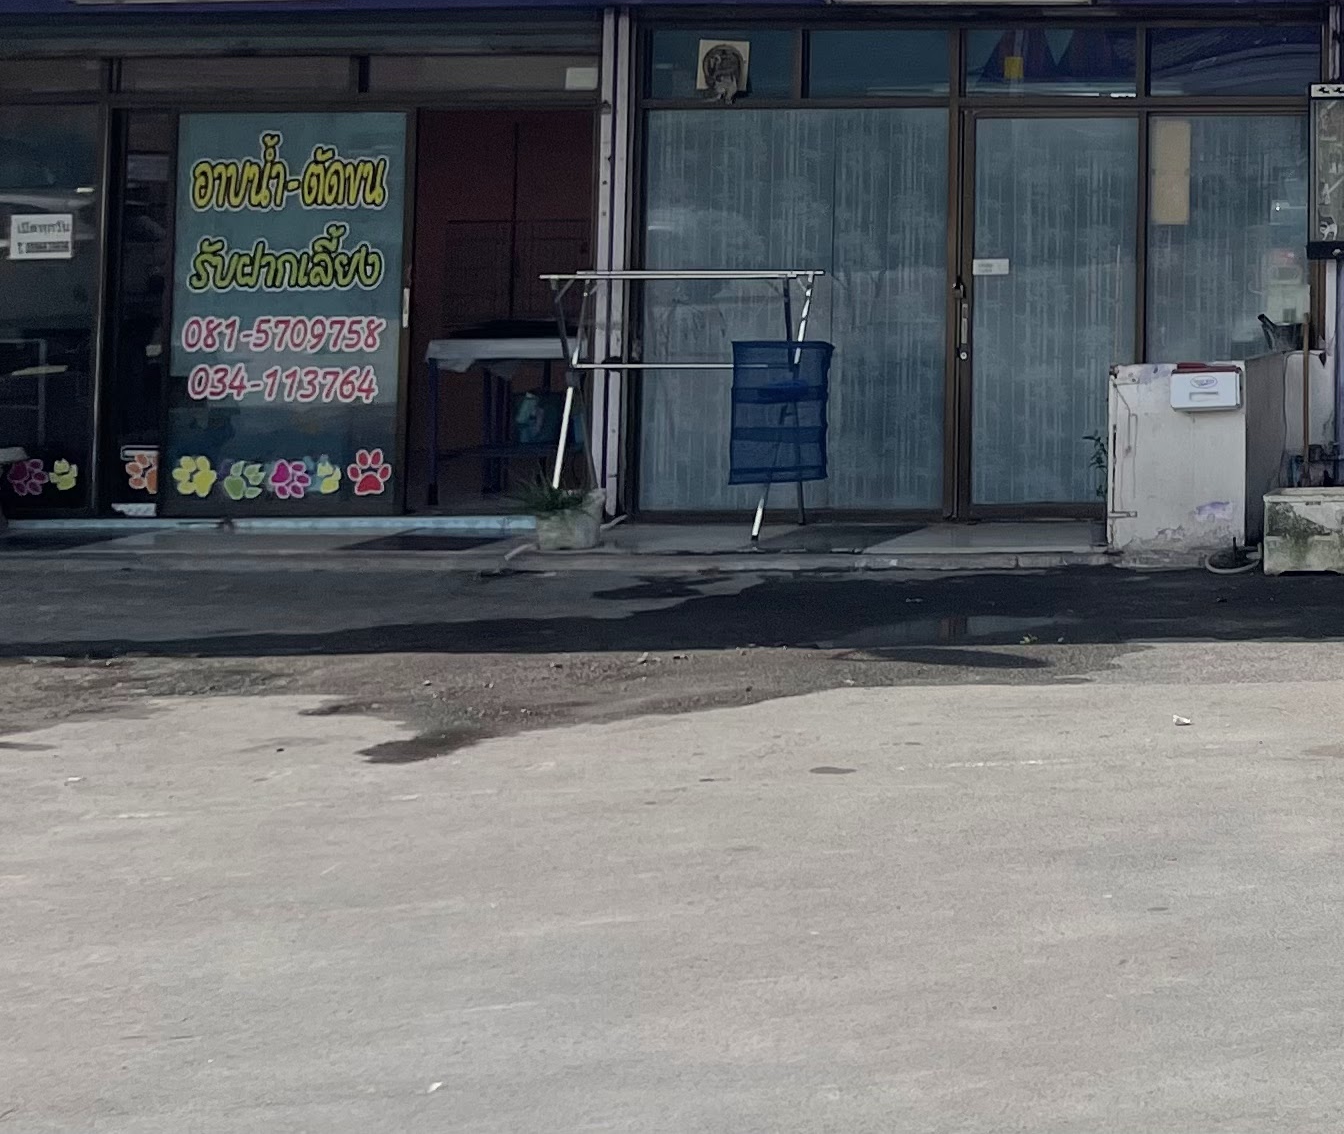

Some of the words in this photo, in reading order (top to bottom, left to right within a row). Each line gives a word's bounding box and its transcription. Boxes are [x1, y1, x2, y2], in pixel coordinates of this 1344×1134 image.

[191, 130, 389, 212] อาบน้ำ-ตัดขน
[187, 221, 385, 293] รับฝากเลี้ยง
[182, 315, 386, 353] 081-5709758
[187, 363, 379, 404] 034-113764
